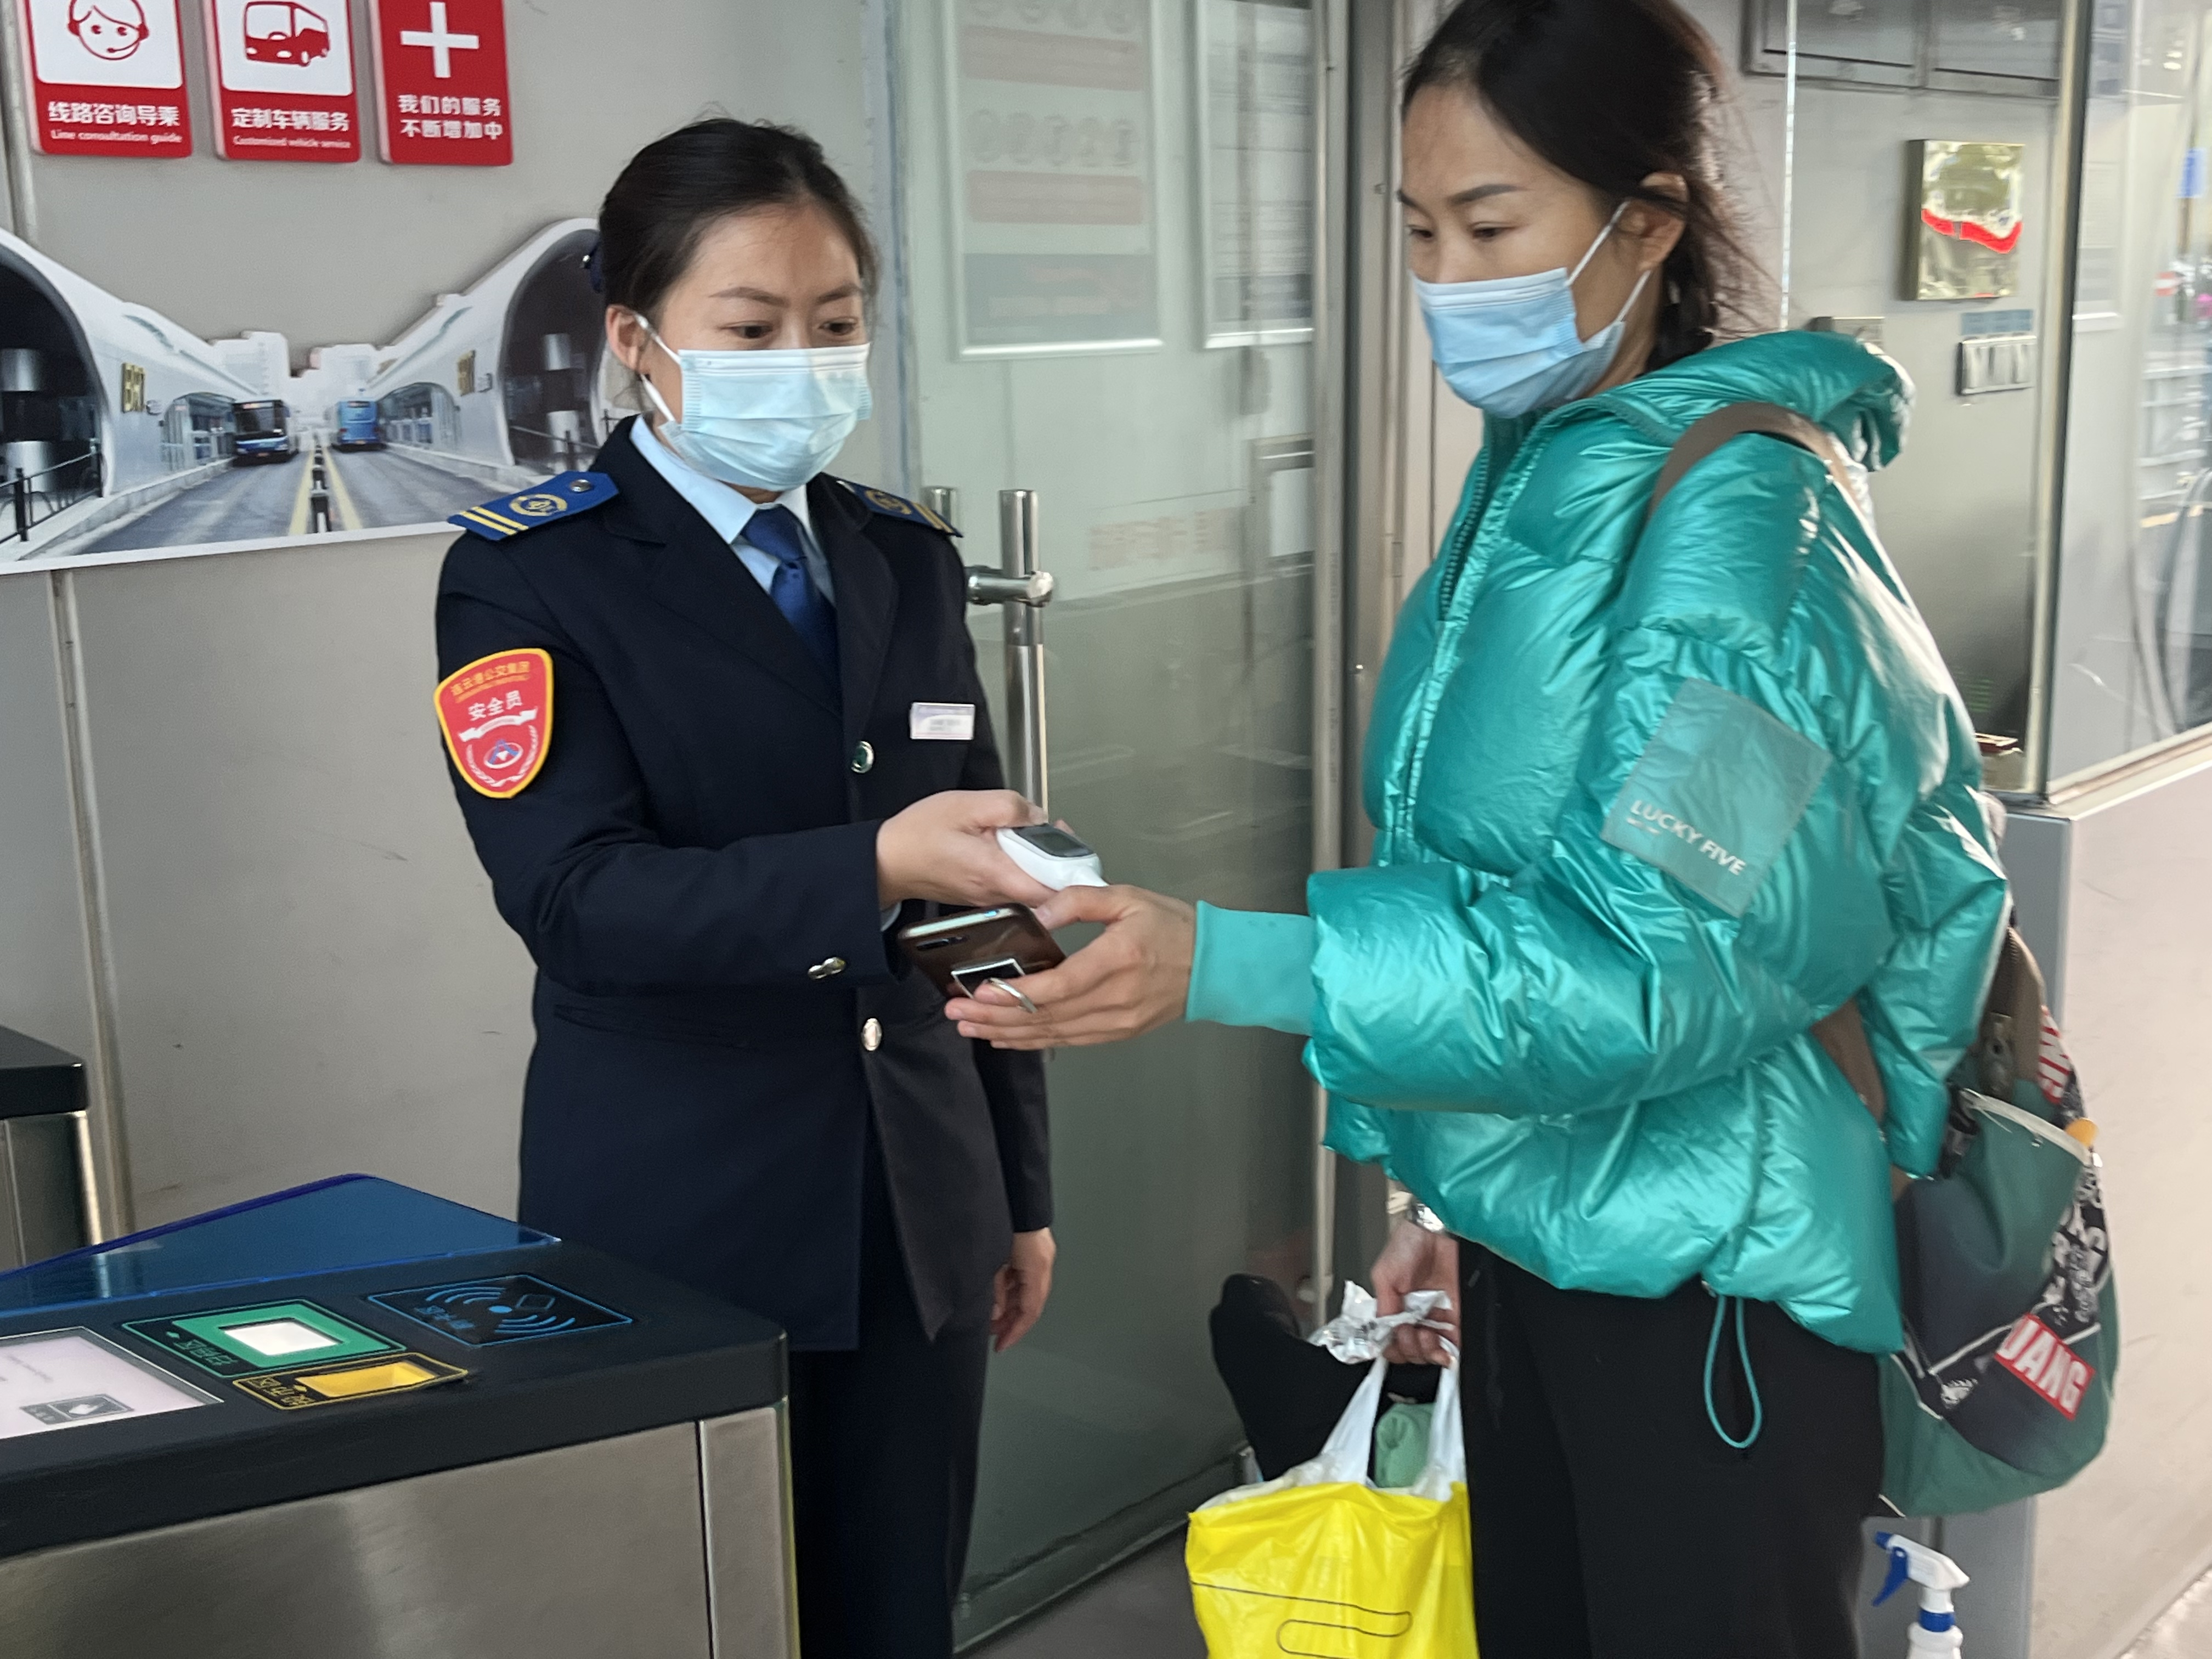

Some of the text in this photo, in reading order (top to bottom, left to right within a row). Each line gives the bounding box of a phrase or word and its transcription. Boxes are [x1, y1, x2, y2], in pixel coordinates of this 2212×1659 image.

[48, 101, 180, 126] 线路咨询导乘
[398, 94, 501, 116] 我们的服务
[231, 107, 350, 131] 定制车辆服务
[400, 119, 503, 140] 不断增加中
[50, 129, 183, 145] Line consultation guide
[468, 690, 523, 721] 安全员
[1630, 799, 1746, 876] LUCKY FIVE
